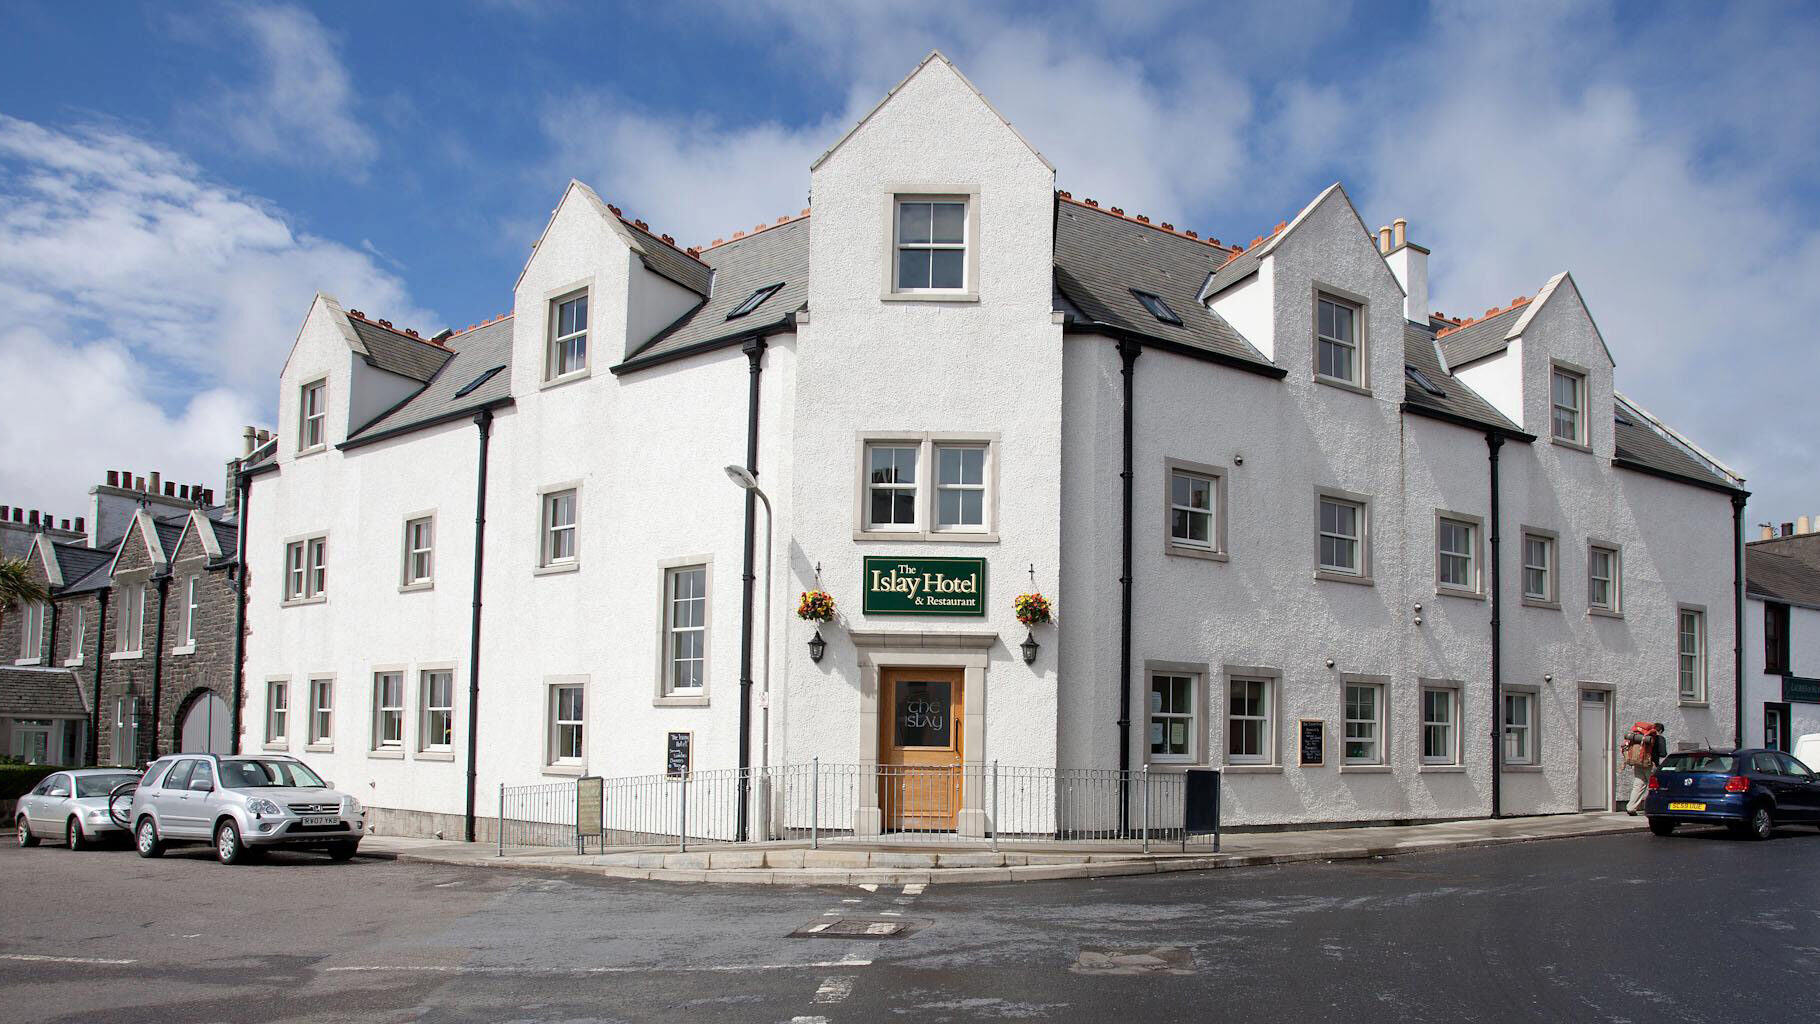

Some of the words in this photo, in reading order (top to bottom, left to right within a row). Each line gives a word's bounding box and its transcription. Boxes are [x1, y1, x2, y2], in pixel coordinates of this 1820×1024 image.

[898, 564, 917, 574] The
[871, 569, 921, 599] Islay
[922, 573, 977, 594] Hotel
[915, 596, 925, 606] &
[927, 596, 976, 606] Restaurant
